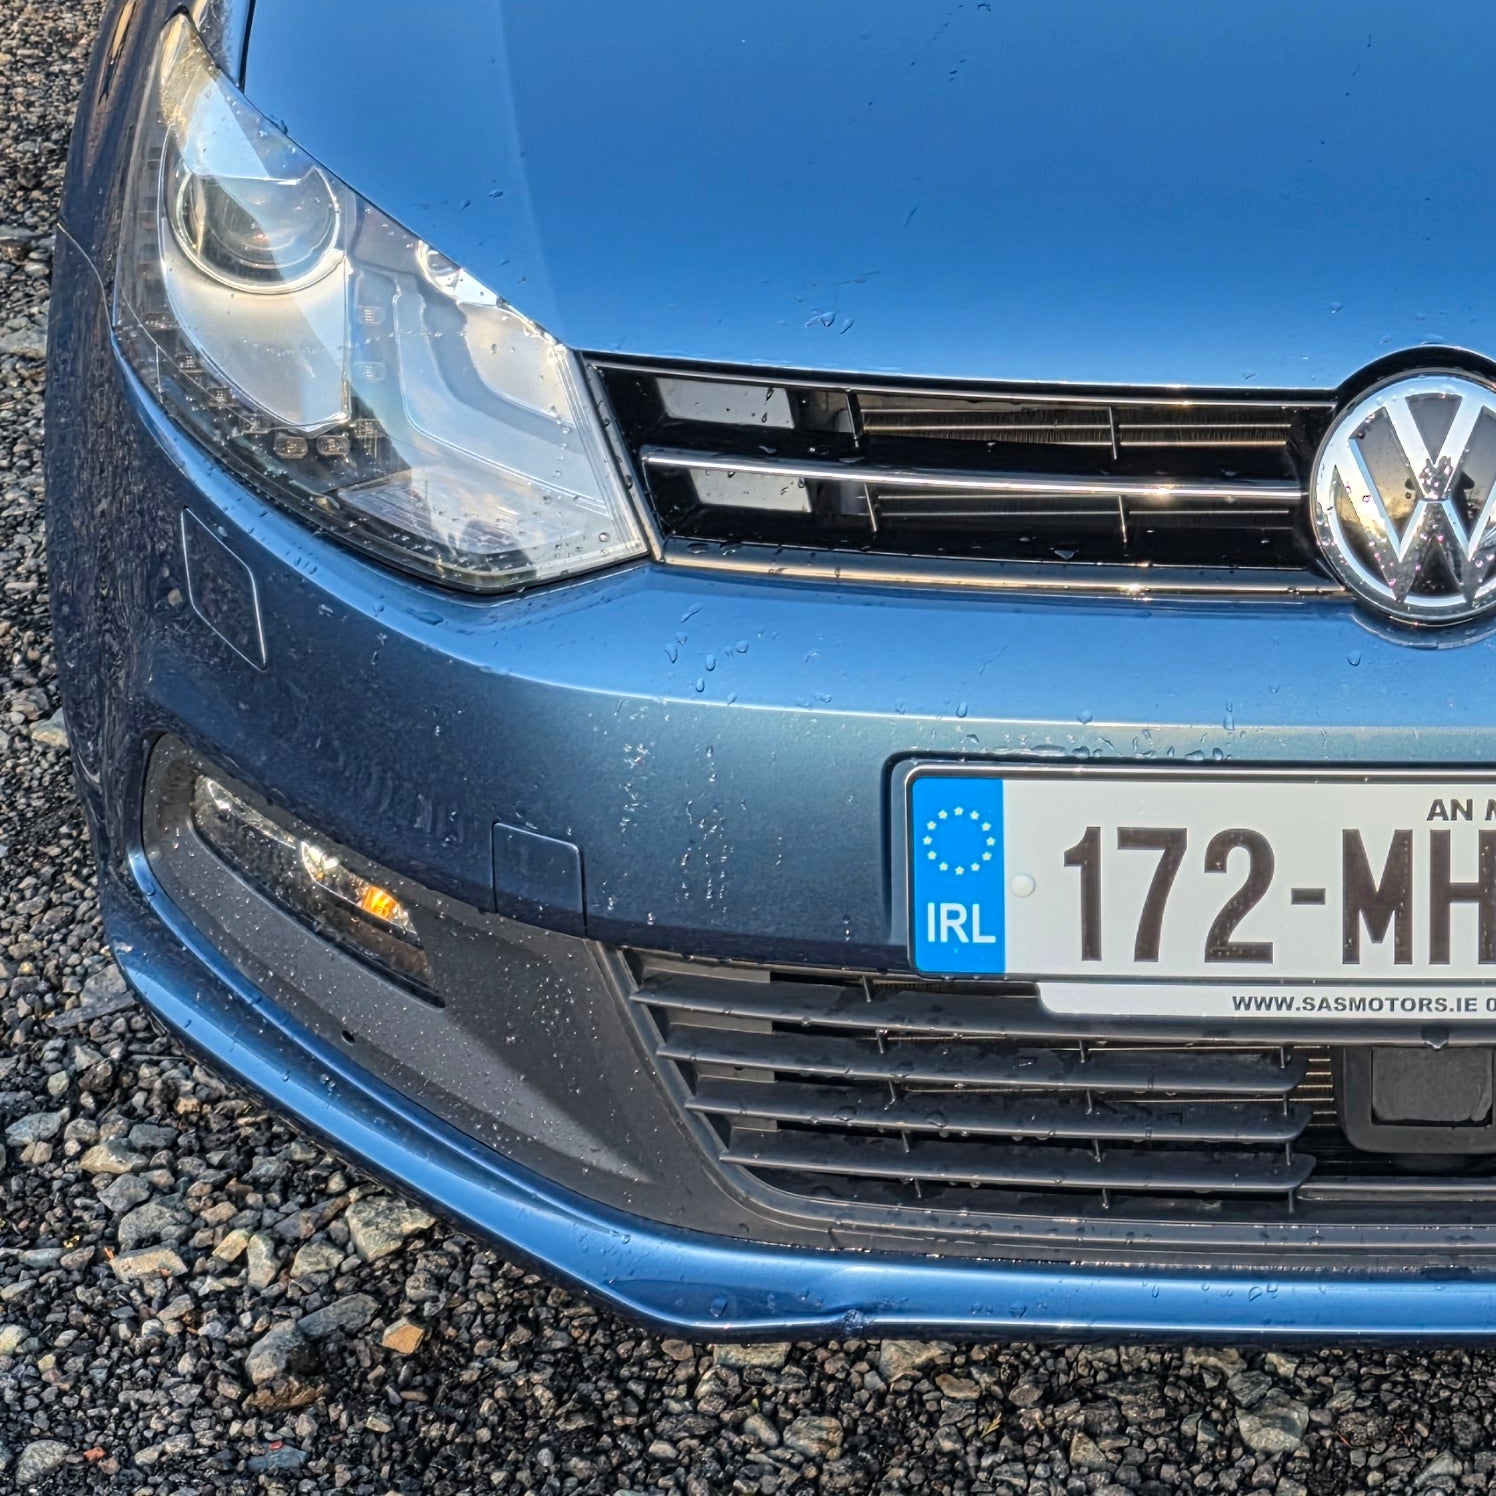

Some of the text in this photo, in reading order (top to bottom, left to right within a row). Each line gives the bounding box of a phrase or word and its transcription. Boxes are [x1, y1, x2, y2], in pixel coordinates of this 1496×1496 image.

[1426, 798, 1474, 822] AN
[927, 901, 997, 944] IRL
[1231, 995, 1479, 1013] WWW.SASMOTORS.IE
